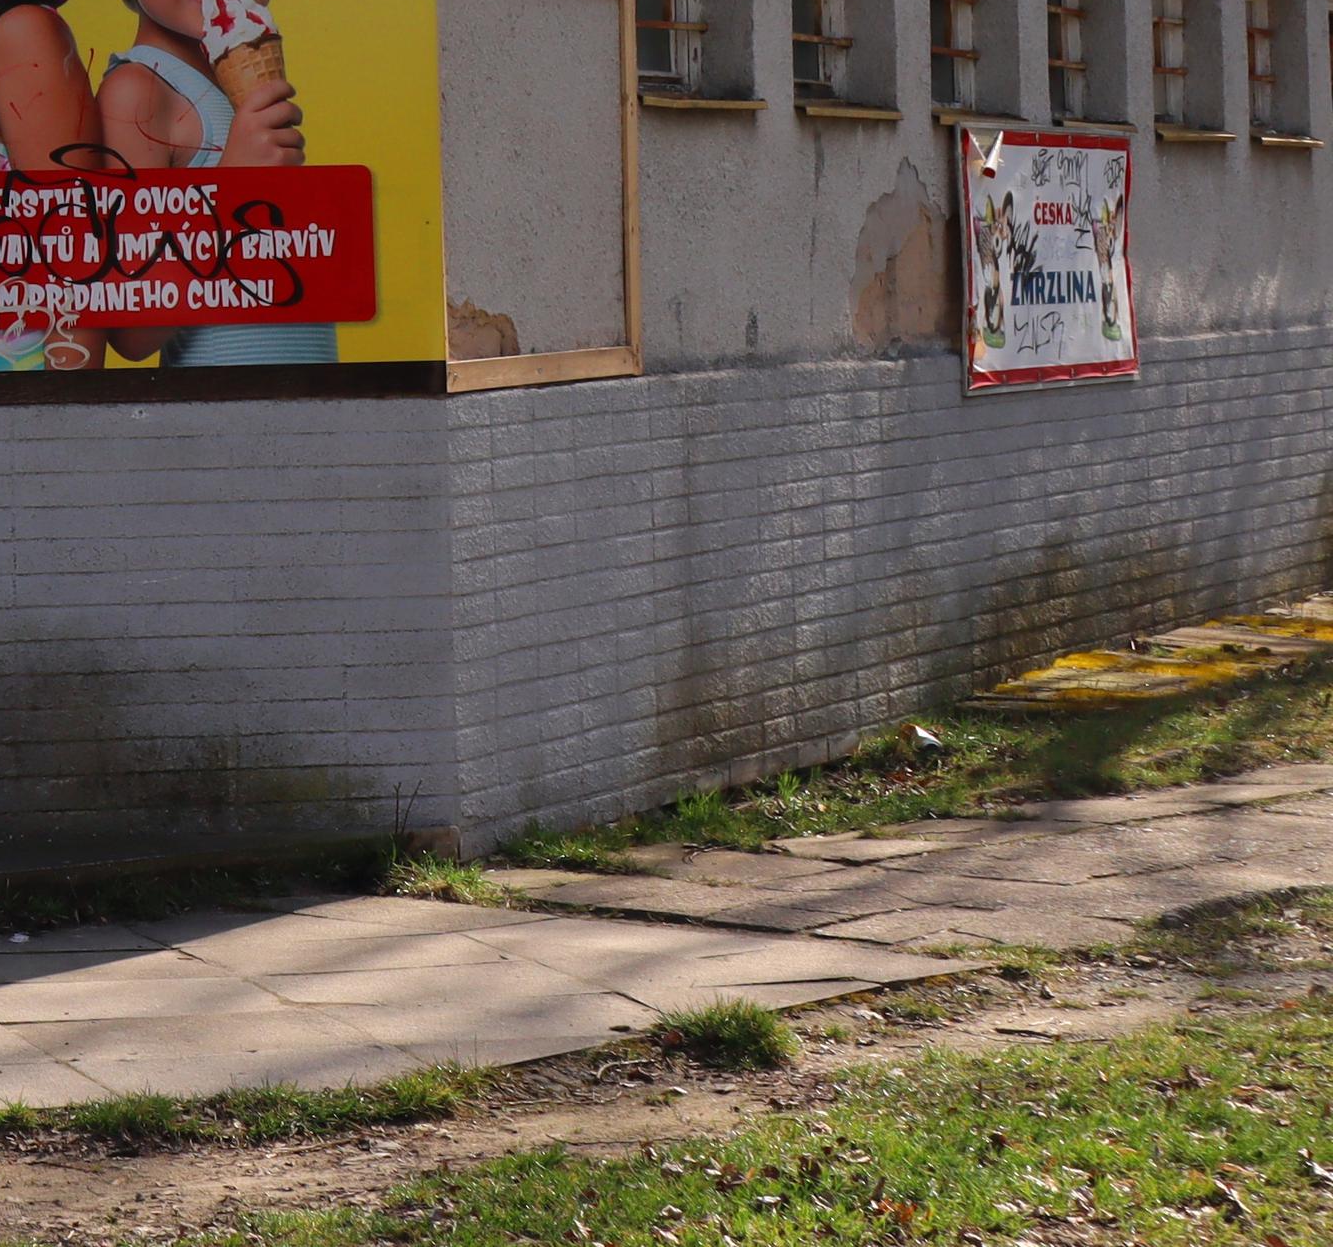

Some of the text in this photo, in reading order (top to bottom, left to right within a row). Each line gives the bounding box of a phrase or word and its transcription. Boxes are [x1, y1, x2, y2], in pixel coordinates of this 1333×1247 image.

[134, 184, 218, 216] OVOCE
[1033, 195, 1073, 226] ČESKÁ
[83, 233, 100, 263] A
[187, 278, 275, 310] CUKRU
[1010, 270, 1097, 306] ZMRZLINA
